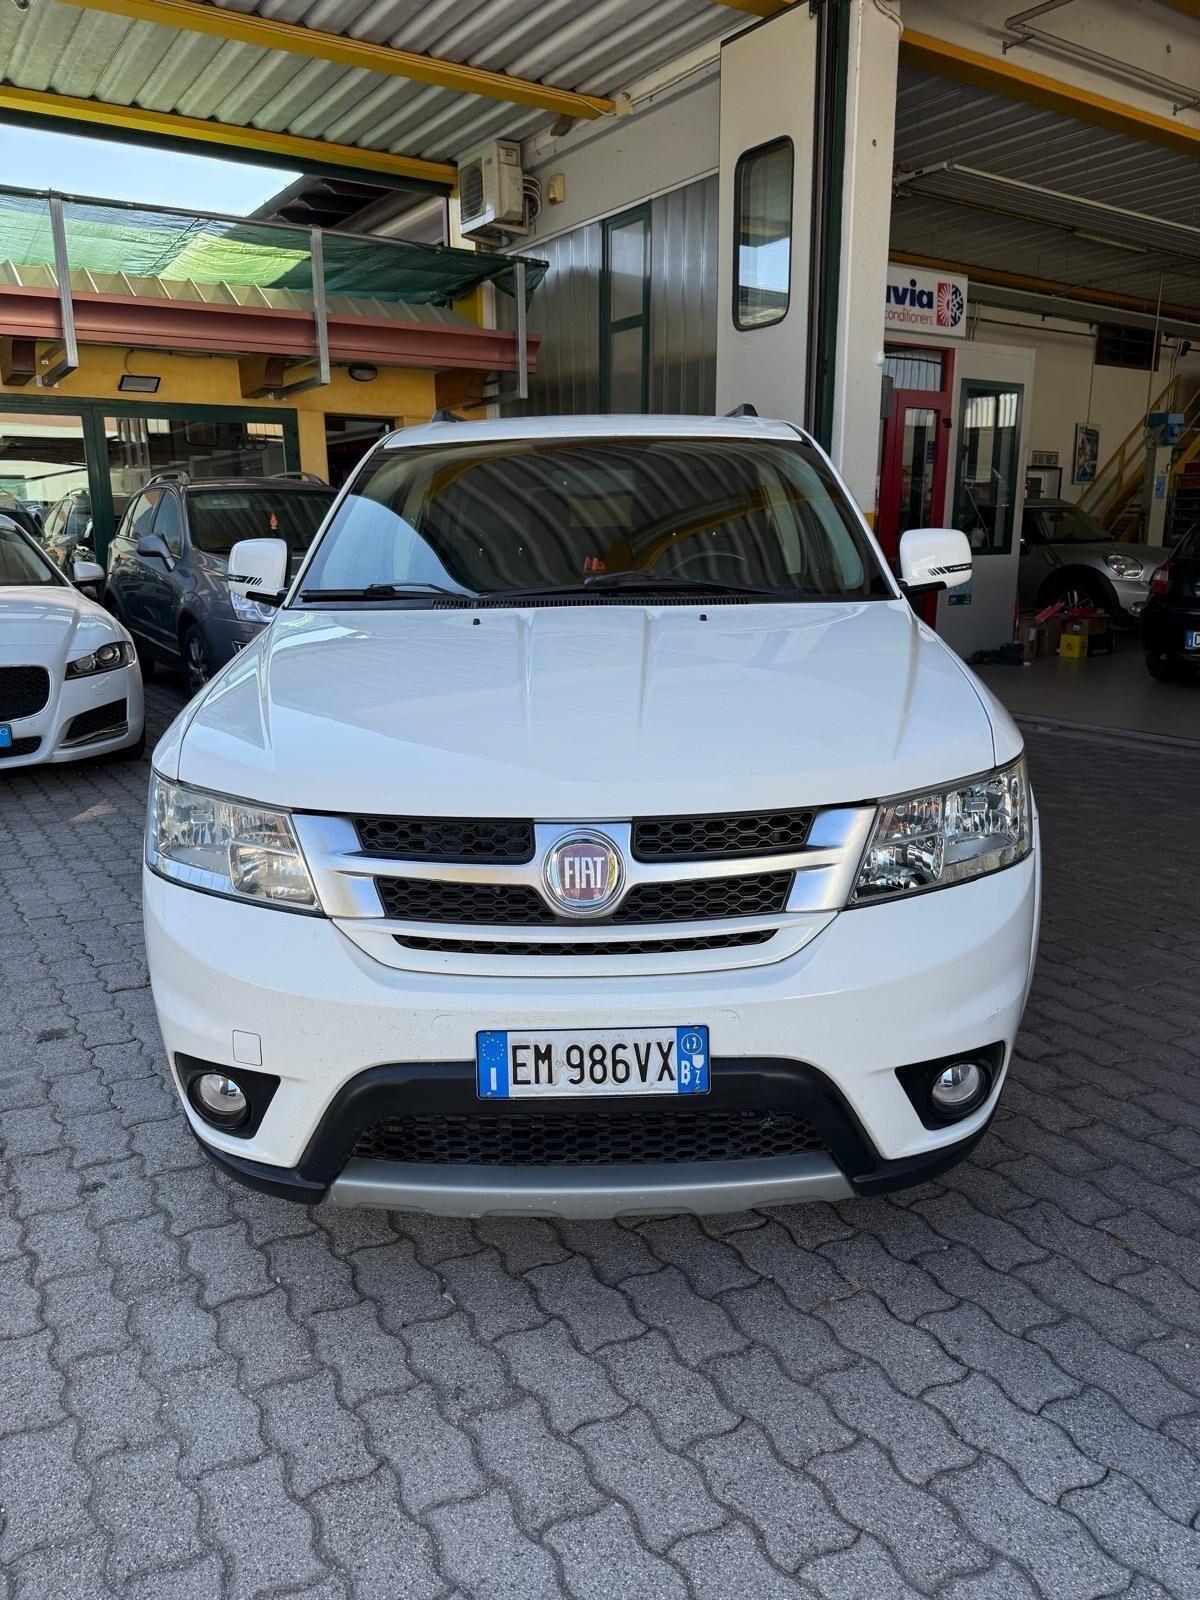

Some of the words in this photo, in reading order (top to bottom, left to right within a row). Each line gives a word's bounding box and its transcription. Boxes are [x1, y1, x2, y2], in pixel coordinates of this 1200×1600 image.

[564, 856, 605, 889] FIAT
[511, 1043, 554, 1086] EM
[565, 1040, 676, 1085] 986VX
